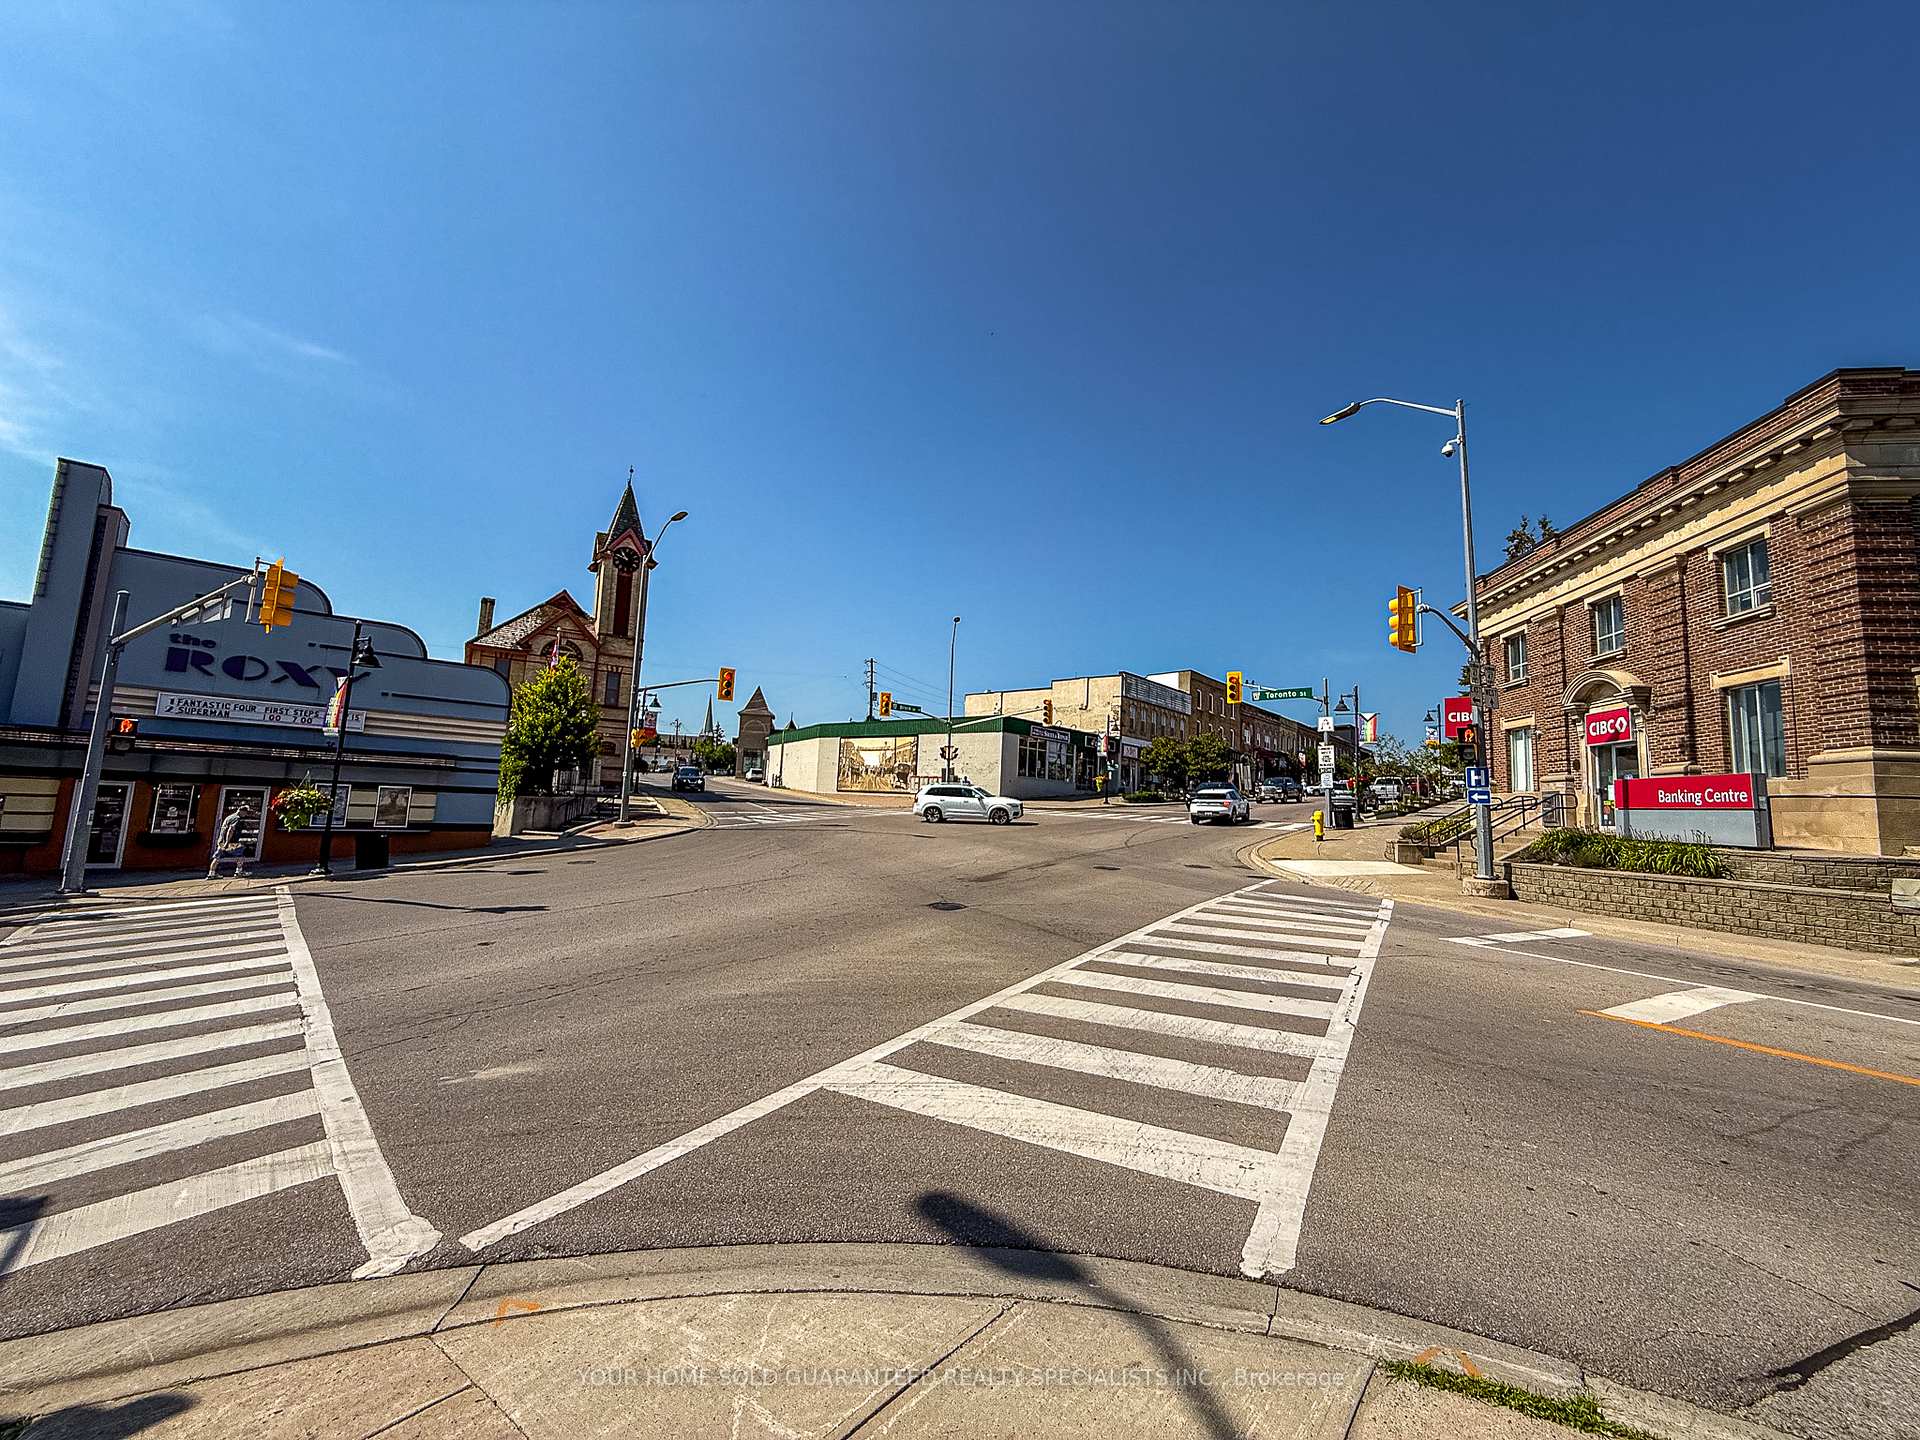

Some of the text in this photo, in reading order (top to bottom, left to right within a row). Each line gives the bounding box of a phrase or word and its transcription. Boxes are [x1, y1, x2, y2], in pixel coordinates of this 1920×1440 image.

[169, 633, 217, 649] the
[165, 646, 371, 689] ROXY
[1265, 691, 1297, 699] Toronto
[175, 706, 230, 719] SUPERMAN
[176, 699, 231, 710] FANTASTIC
[233, 703, 257, 713] FOUR
[264, 706, 290, 715] FIRST
[293, 708, 321, 718] STEPS
[1448, 711, 1472, 723] CIB
[1589, 718, 1616, 737] CIBC
[1470, 770, 1486, 787] H
[1658, 788, 1748, 806] Banking Centre
